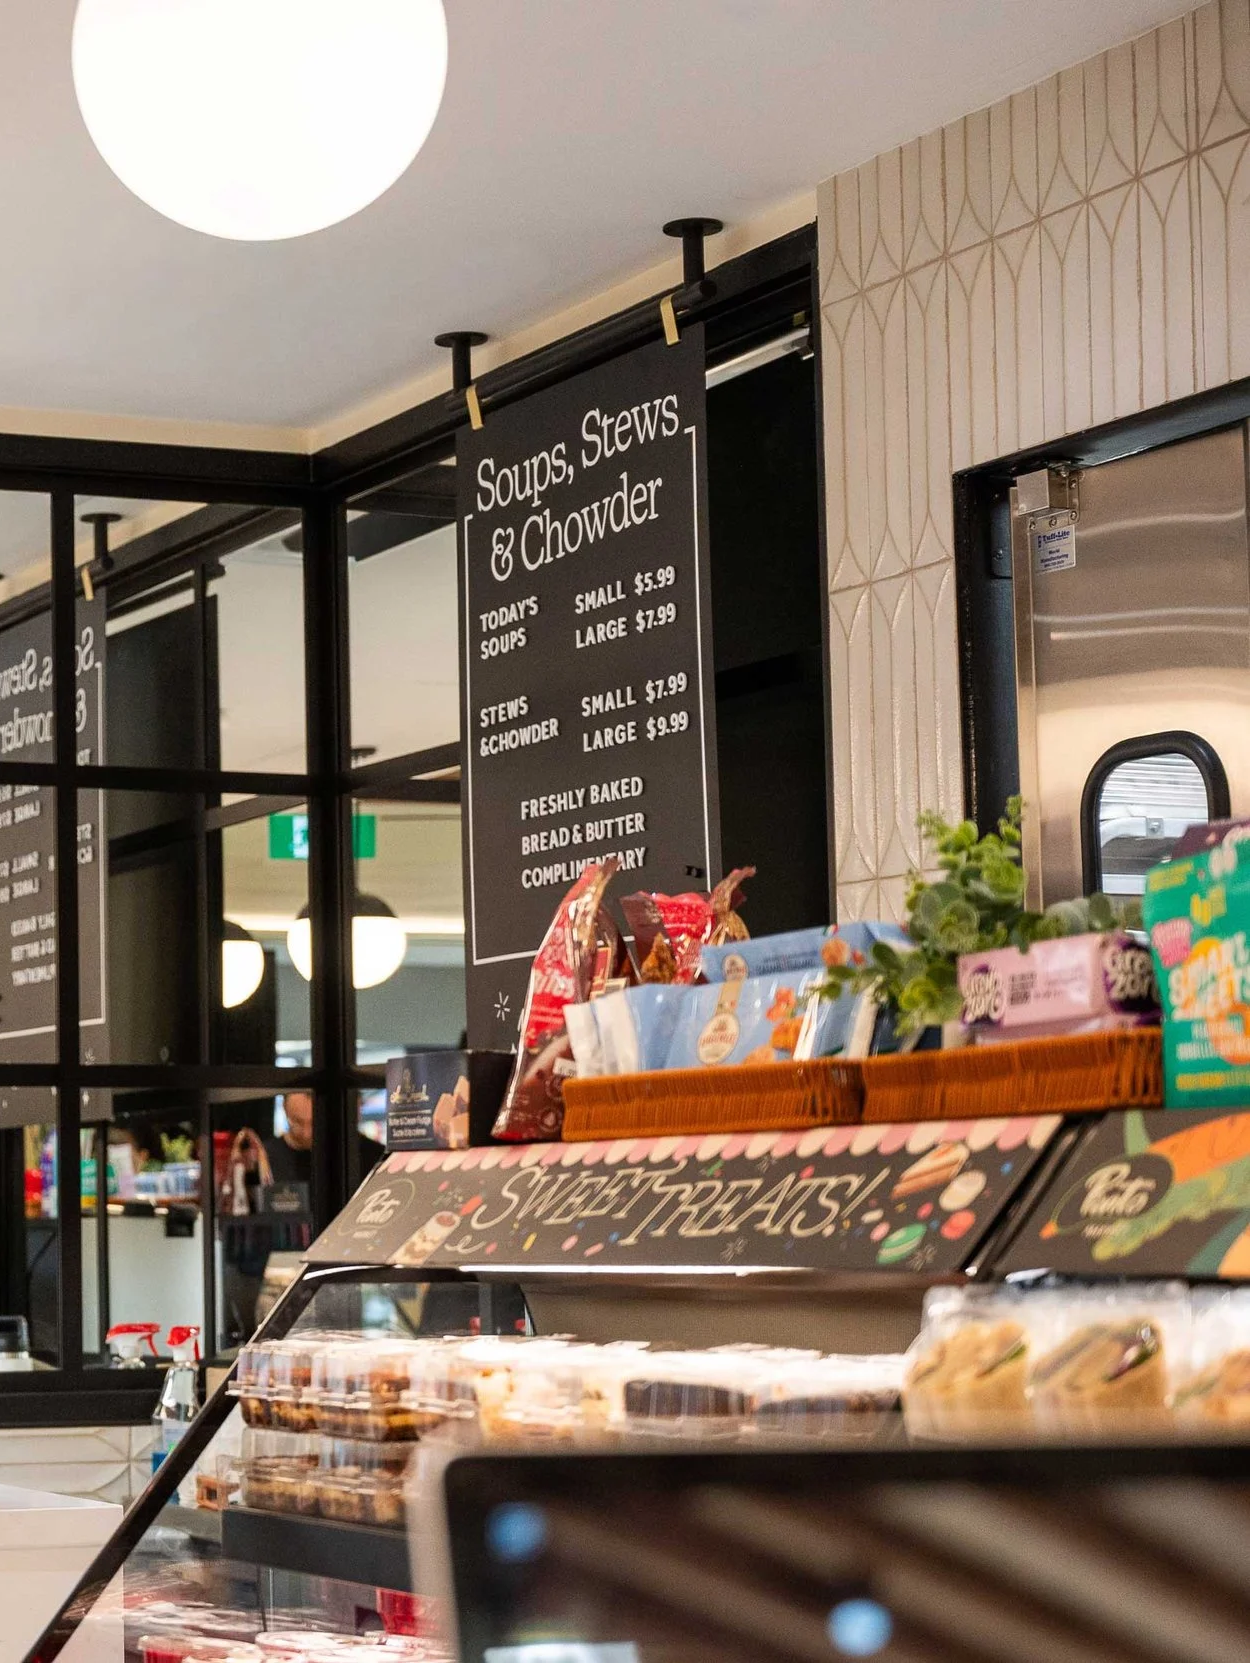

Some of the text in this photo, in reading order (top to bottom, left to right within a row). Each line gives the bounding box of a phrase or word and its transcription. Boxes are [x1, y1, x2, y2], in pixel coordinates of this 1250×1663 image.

[477, 394, 680, 512] Soups, Stews
[490, 471, 663, 582] & Chowder
[574, 565, 677, 615] SMALL $5.99
[479, 595, 540, 633] TODAY'S
[575, 602, 678, 649] LARGE $7.99
[480, 627, 528, 660] SOUPS
[479, 695, 530, 728] STEWS
[581, 671, 689, 718] SMALL $7.99
[582, 710, 690, 753] LARGE $9.99
[520, 776, 644, 821] FRESHLY BAKED
[521, 812, 646, 856] BREAD & BUTTER
[471, 1159, 891, 1246] SWEET TREATS!
